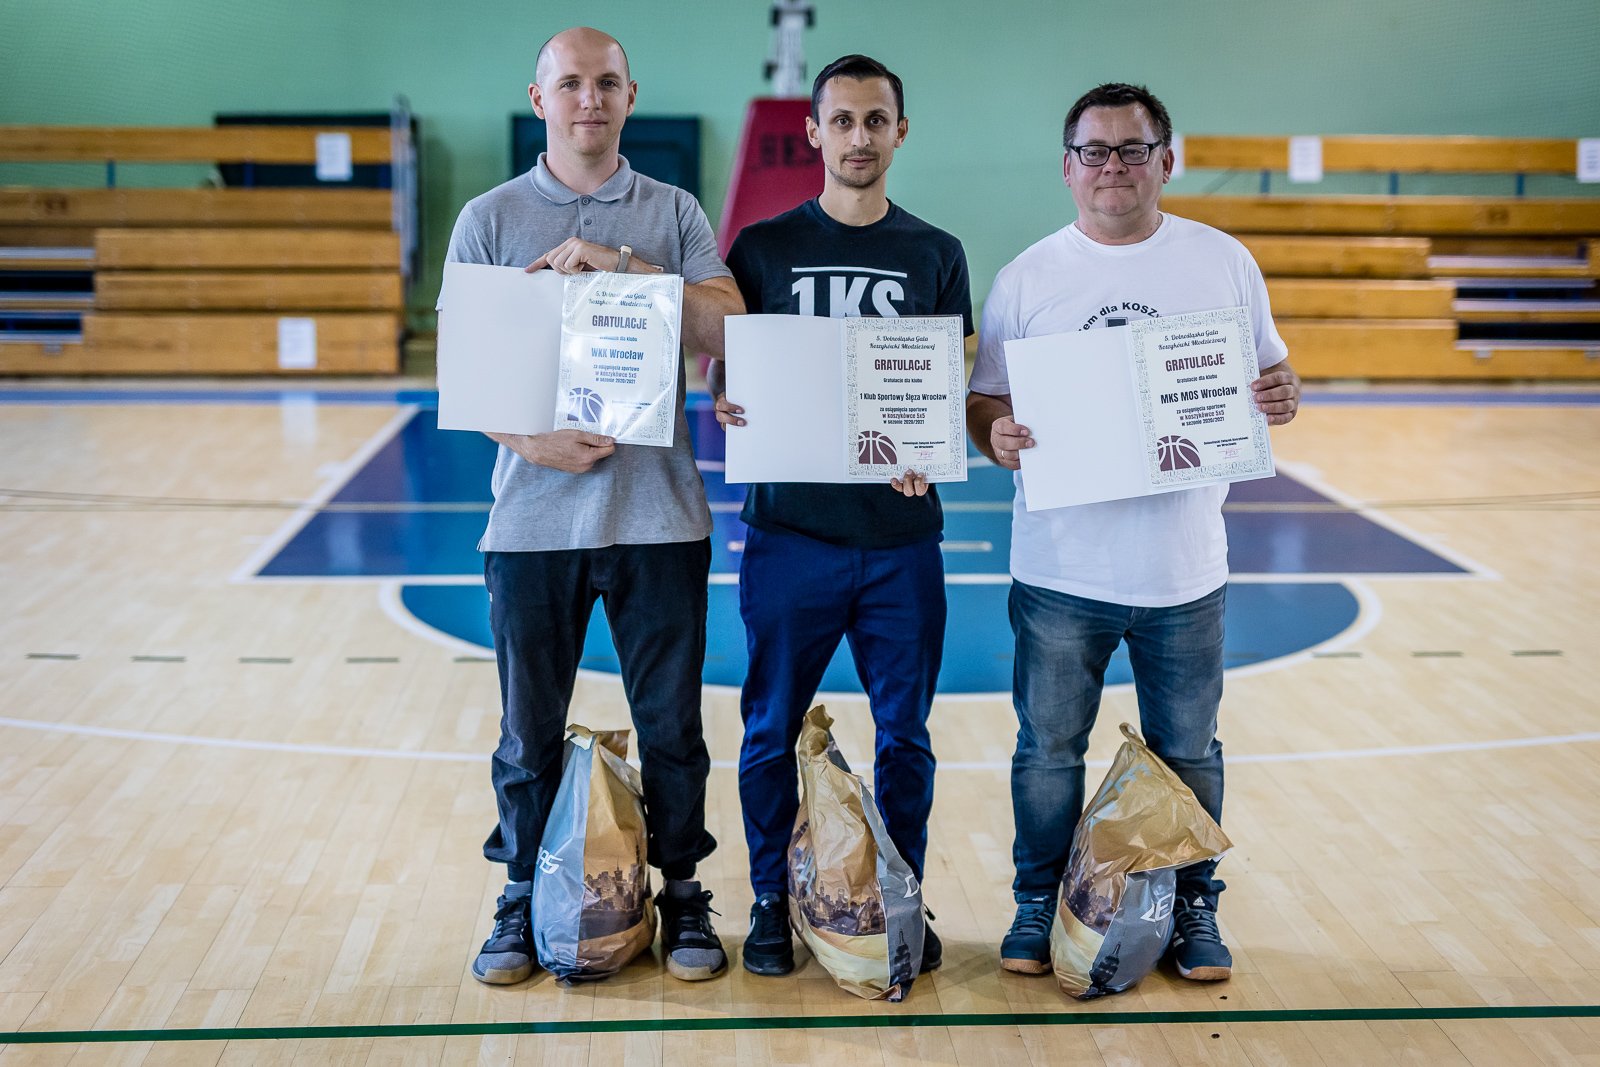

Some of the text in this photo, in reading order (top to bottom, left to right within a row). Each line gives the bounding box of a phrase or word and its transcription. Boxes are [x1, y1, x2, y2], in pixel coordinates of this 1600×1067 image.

[592, 314, 648, 330] GRATULACJE
[1078, 315, 1098, 332] em
[1099, 305, 1118, 316] dla
[1205, 329, 1219, 338] Gala
[591, 347, 644, 361] WKK Wrocław
[874, 359, 932, 371] GRATULACJE
[1165, 353, 1226, 372] GRATULACJE
[863, 392, 877, 400] Klub
[877, 393, 904, 402] Sportowy
[905, 392, 921, 403] Ślęza
[921, 393, 947, 401] Wrocław
[1160, 386, 1238, 404] MKS MOS Wrocław
